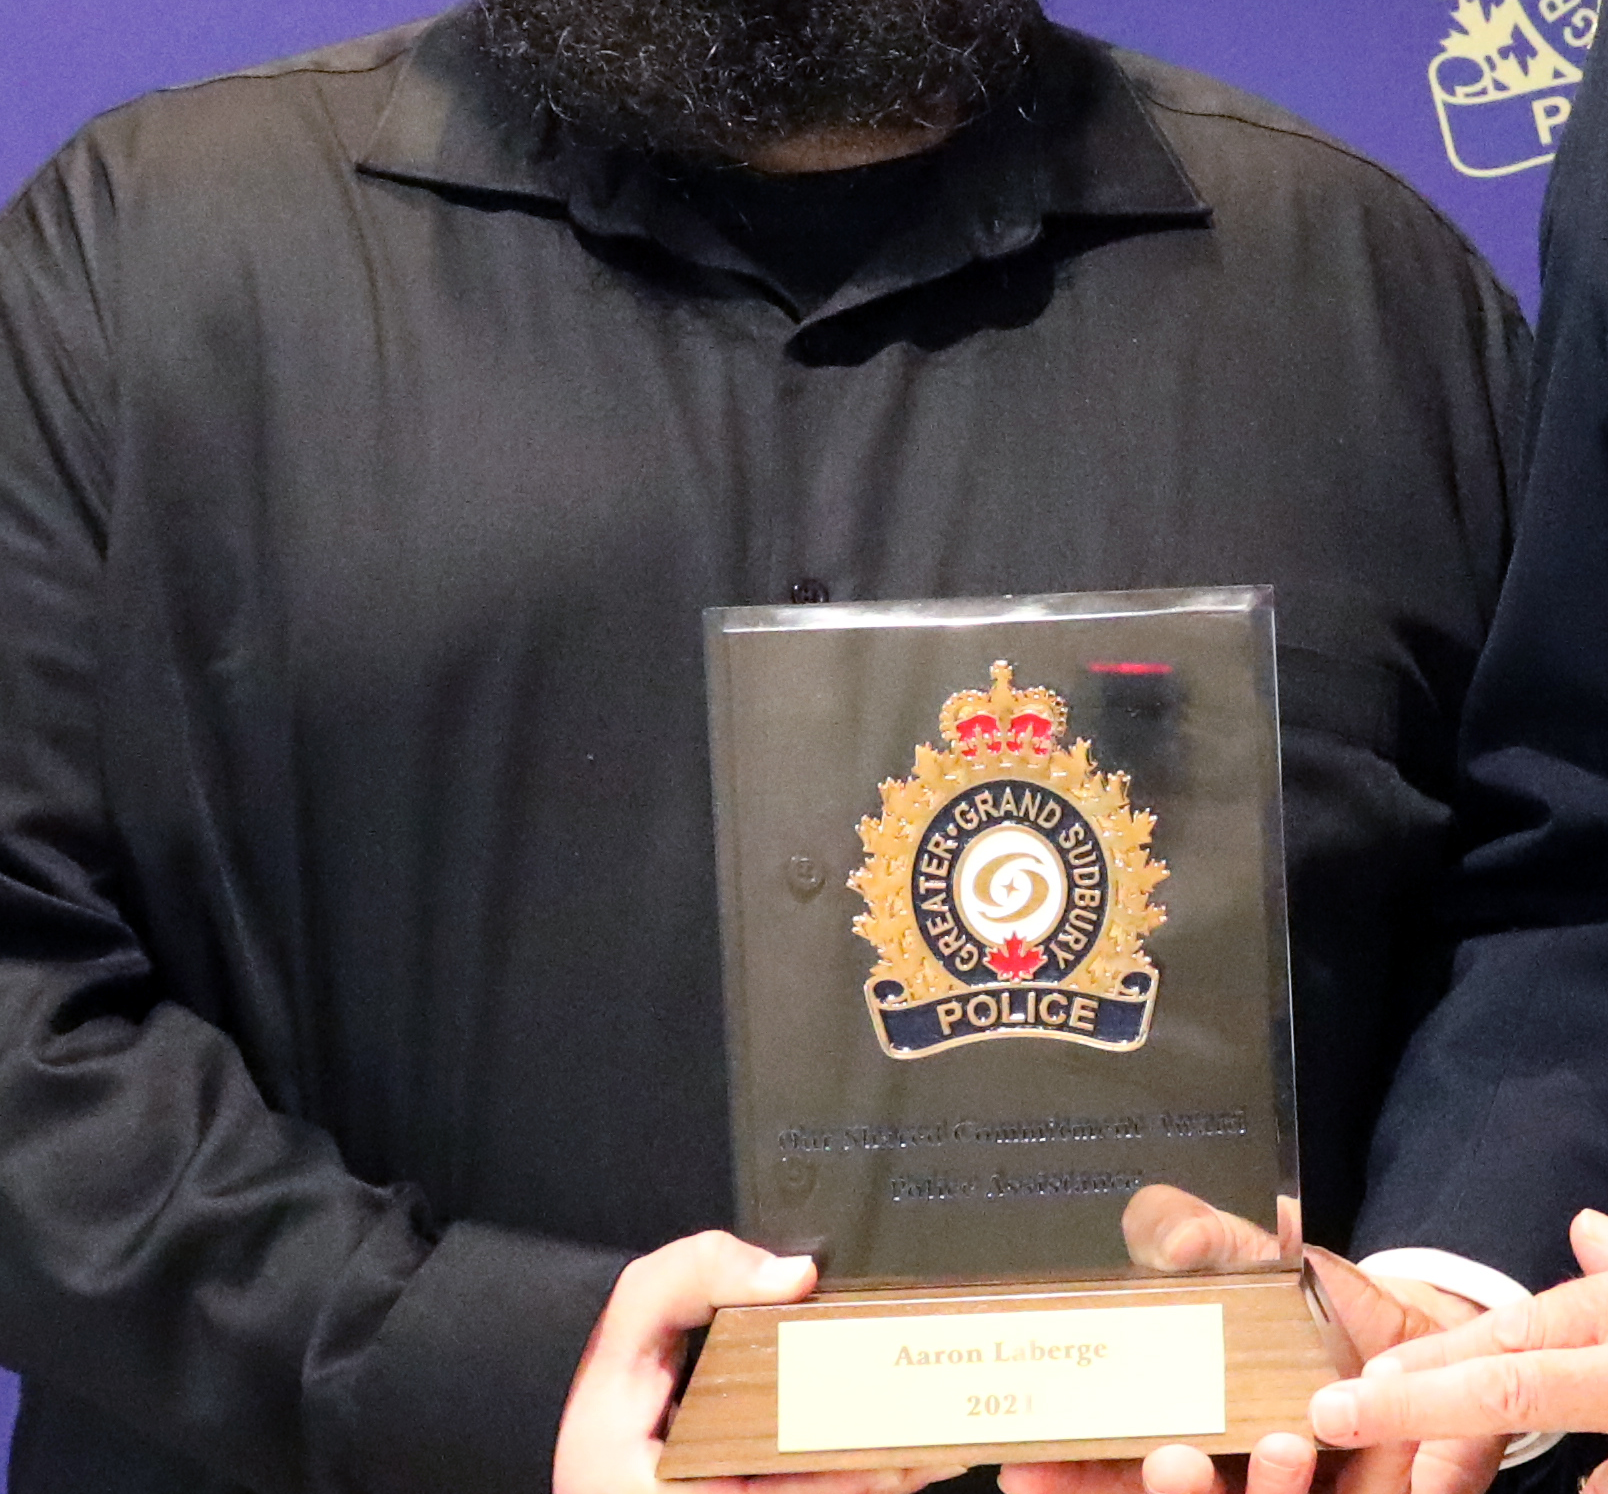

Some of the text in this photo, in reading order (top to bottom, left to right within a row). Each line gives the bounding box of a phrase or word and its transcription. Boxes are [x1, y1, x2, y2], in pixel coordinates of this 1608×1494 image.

[921, 786, 1100, 972] GREATER GRAND SUDBURY
[937, 992, 1098, 1034] POLICE
[893, 1340, 1109, 1367] Aaron Laberge
[967, 1393, 1035, 1417] 2021
